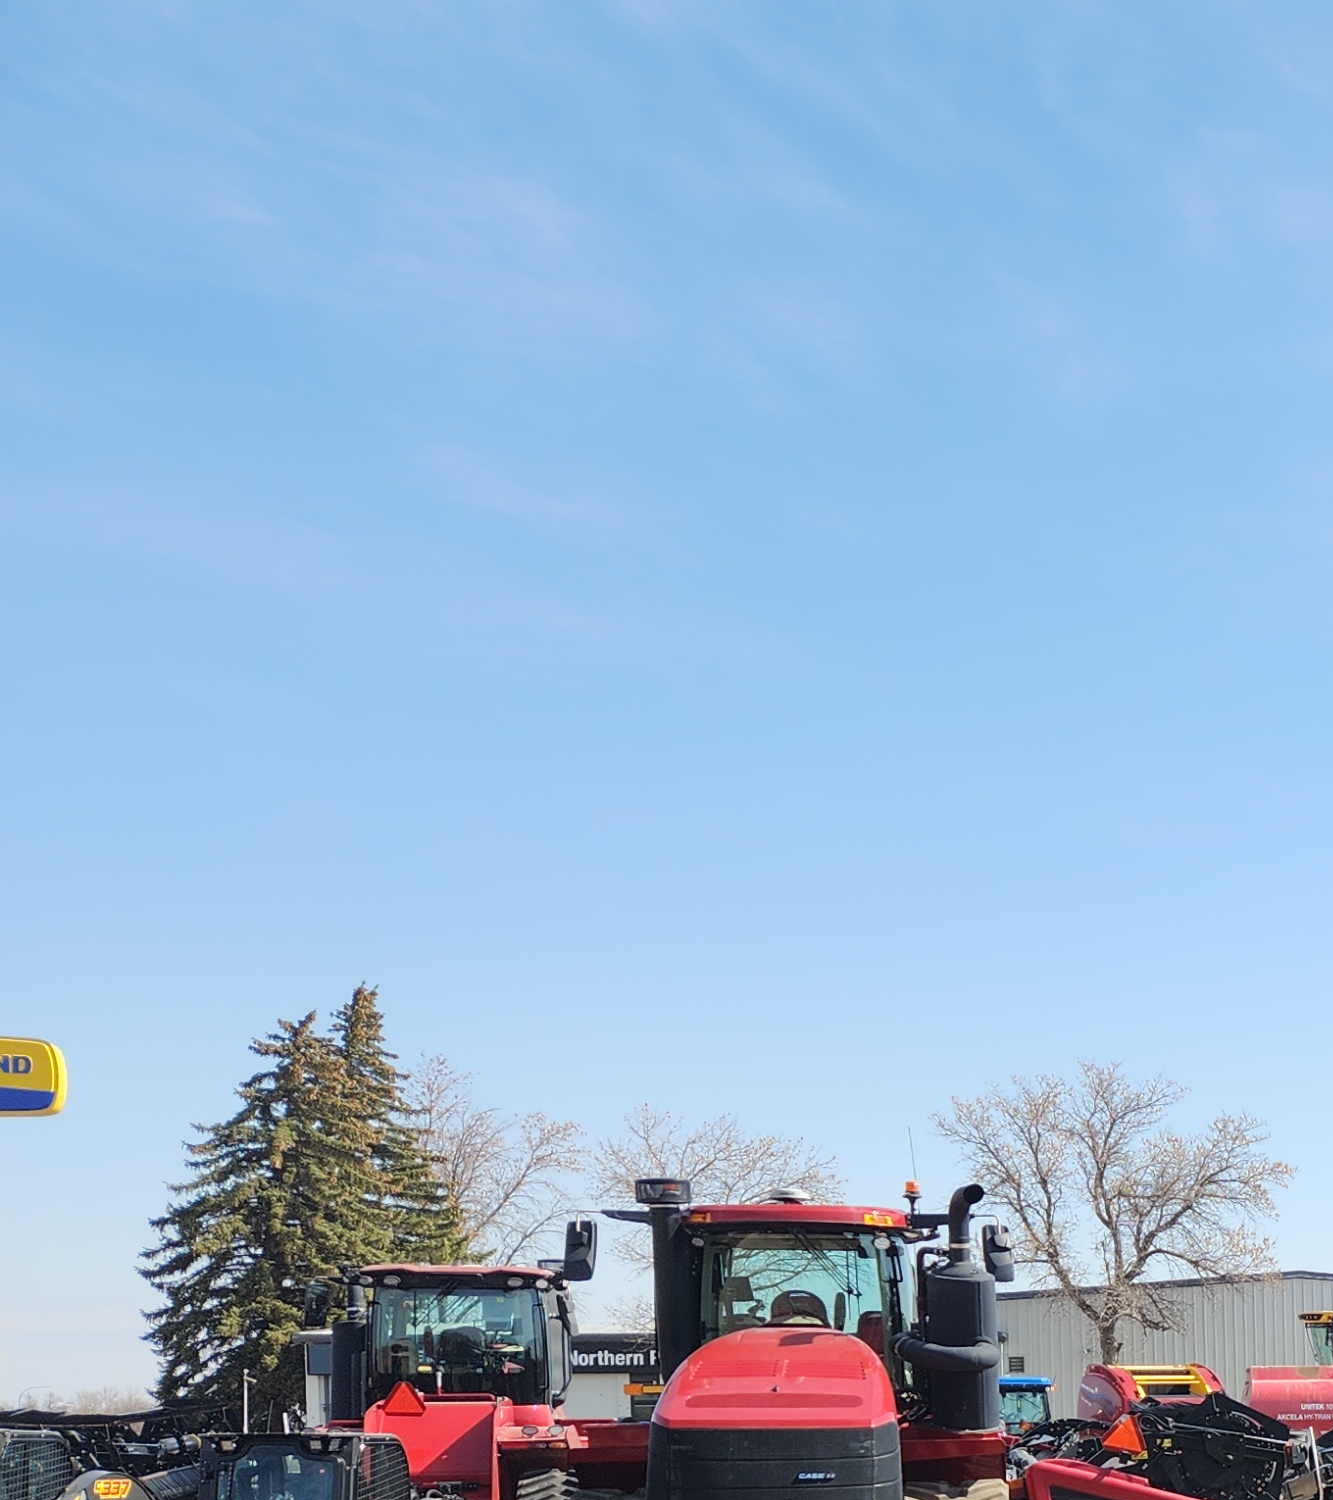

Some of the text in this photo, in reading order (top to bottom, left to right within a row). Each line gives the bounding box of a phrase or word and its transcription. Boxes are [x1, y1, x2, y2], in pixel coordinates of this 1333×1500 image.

[570, 1350, 644, 1367] Northern
[1300, 1403, 1325, 1411] UNITEK
[1276, 1413, 1303, 1421] AKCELA
[798, 1472, 826, 1480] CASE
